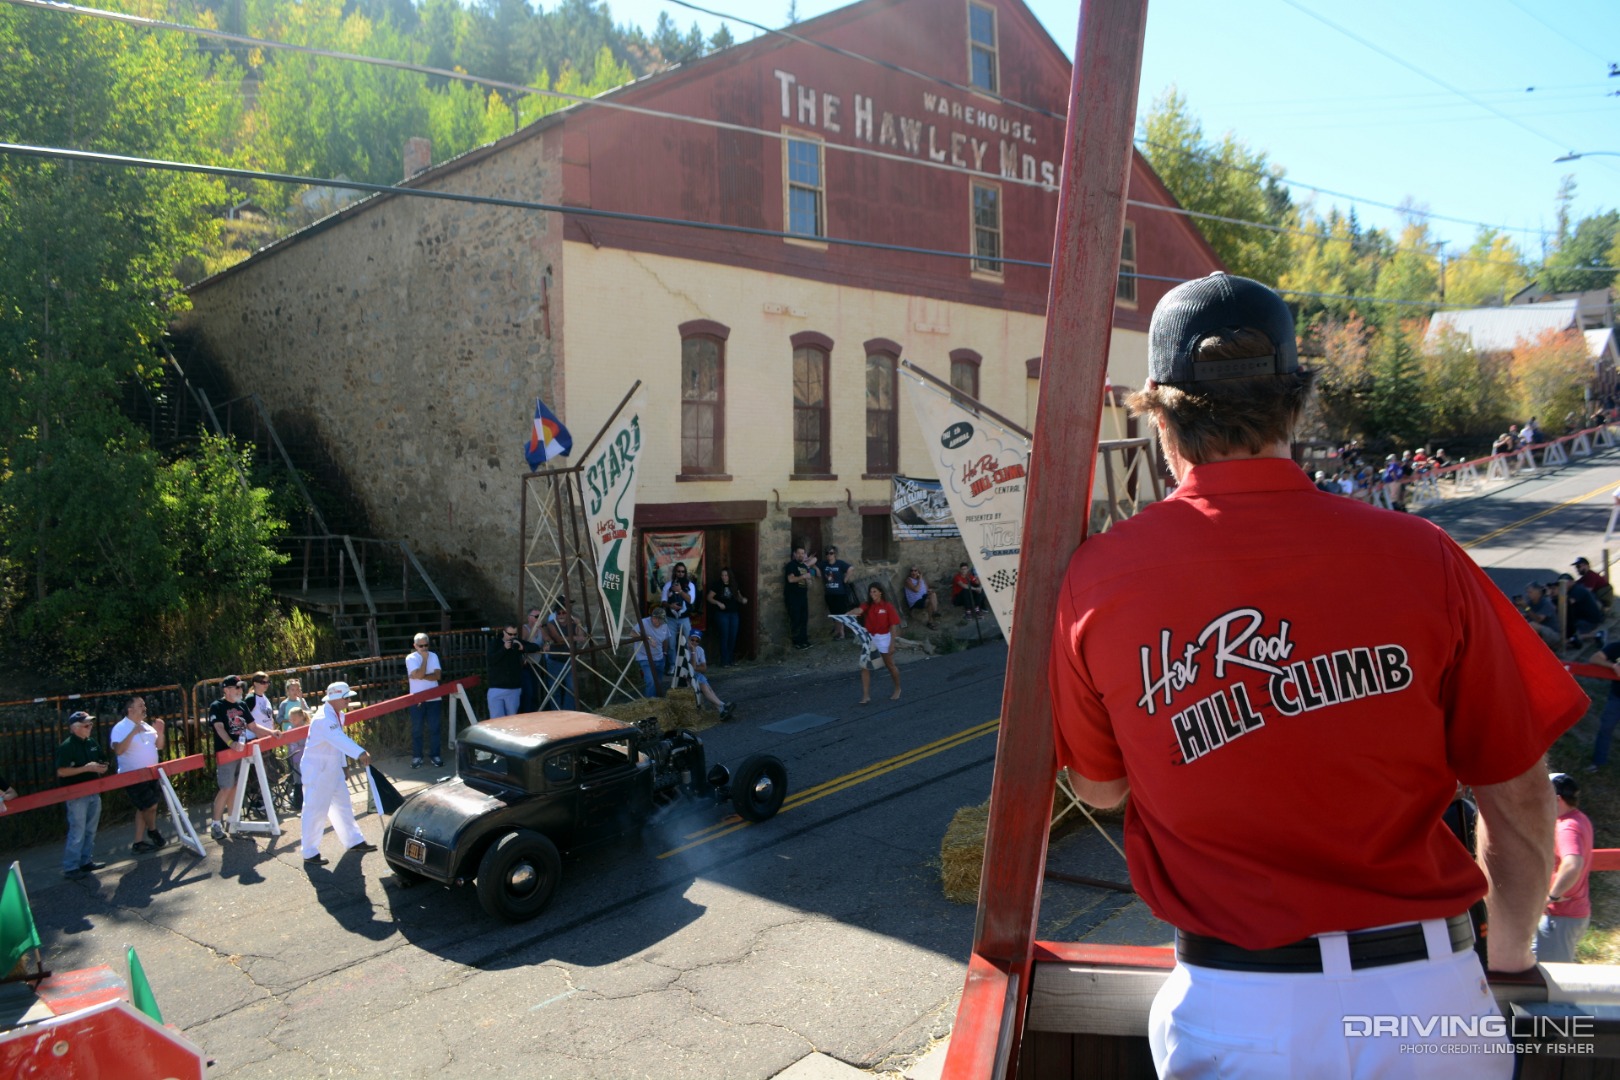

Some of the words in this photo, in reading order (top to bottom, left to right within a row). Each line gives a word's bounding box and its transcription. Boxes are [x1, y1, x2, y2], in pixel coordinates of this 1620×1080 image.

[774, 69, 840, 133] THE
[854, 93, 988, 171] HAWLEY
[923, 91, 1037, 144] WAREHOUSE.
[586, 413, 641, 515] START
[970, 475, 993, 498] HILL
[992, 463, 1026, 485] CLIMB
[994, 484, 1021, 495] CENTRAL
[965, 513, 993, 523] PRESENTED
[994, 512, 1002, 520] BY
[602, 580, 620, 591] FEET
[1136, 627, 1201, 716] Hot
[1197, 606, 1296, 679] Rod
[1170, 681, 1265, 765] HILL
[1268, 643, 1414, 717] CLIMB
